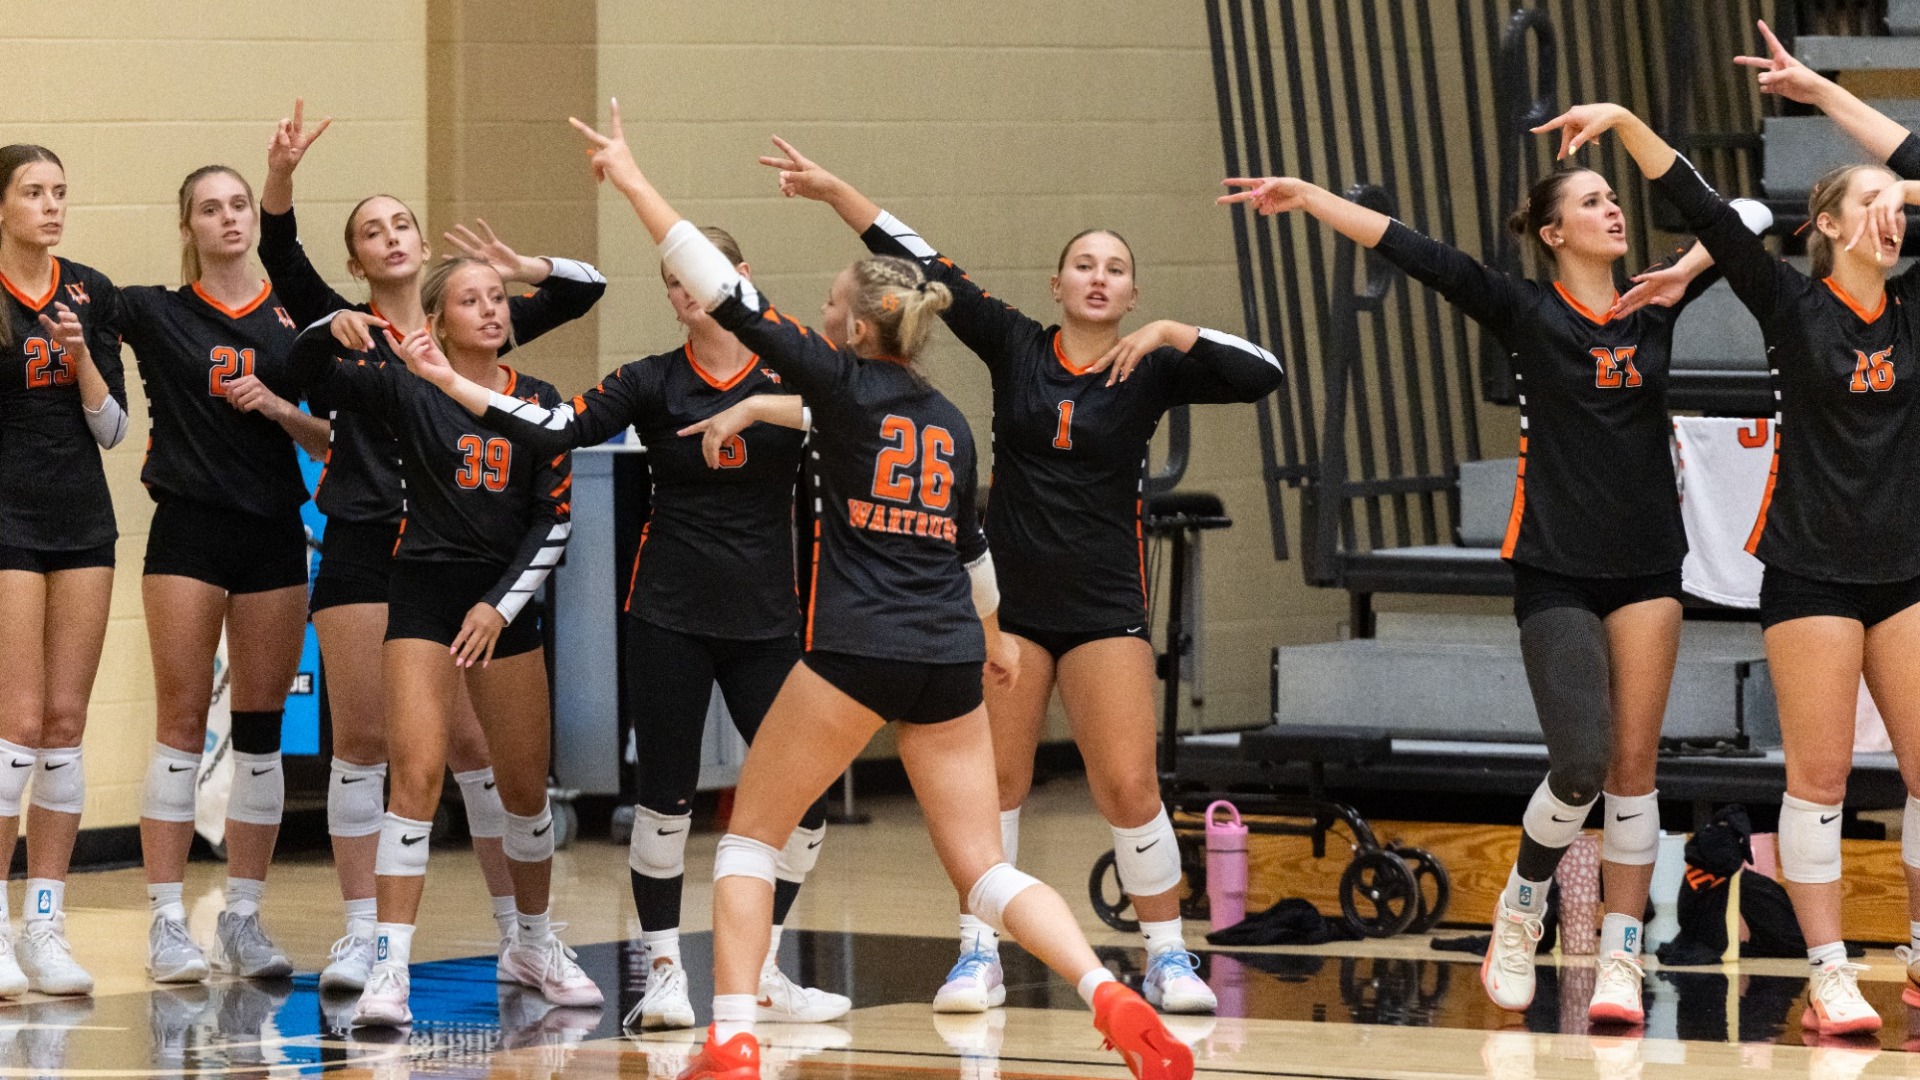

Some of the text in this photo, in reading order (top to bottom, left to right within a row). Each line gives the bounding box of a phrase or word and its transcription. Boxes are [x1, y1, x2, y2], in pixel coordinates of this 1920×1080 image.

[24, 336, 77, 390] 23
[208, 345, 256, 398] 21
[1588, 344, 1643, 389] 27
[1849, 344, 1896, 393] 16
[1052, 400, 1075, 450] 1
[455, 434, 512, 492] 39
[871, 414, 955, 511] 26
